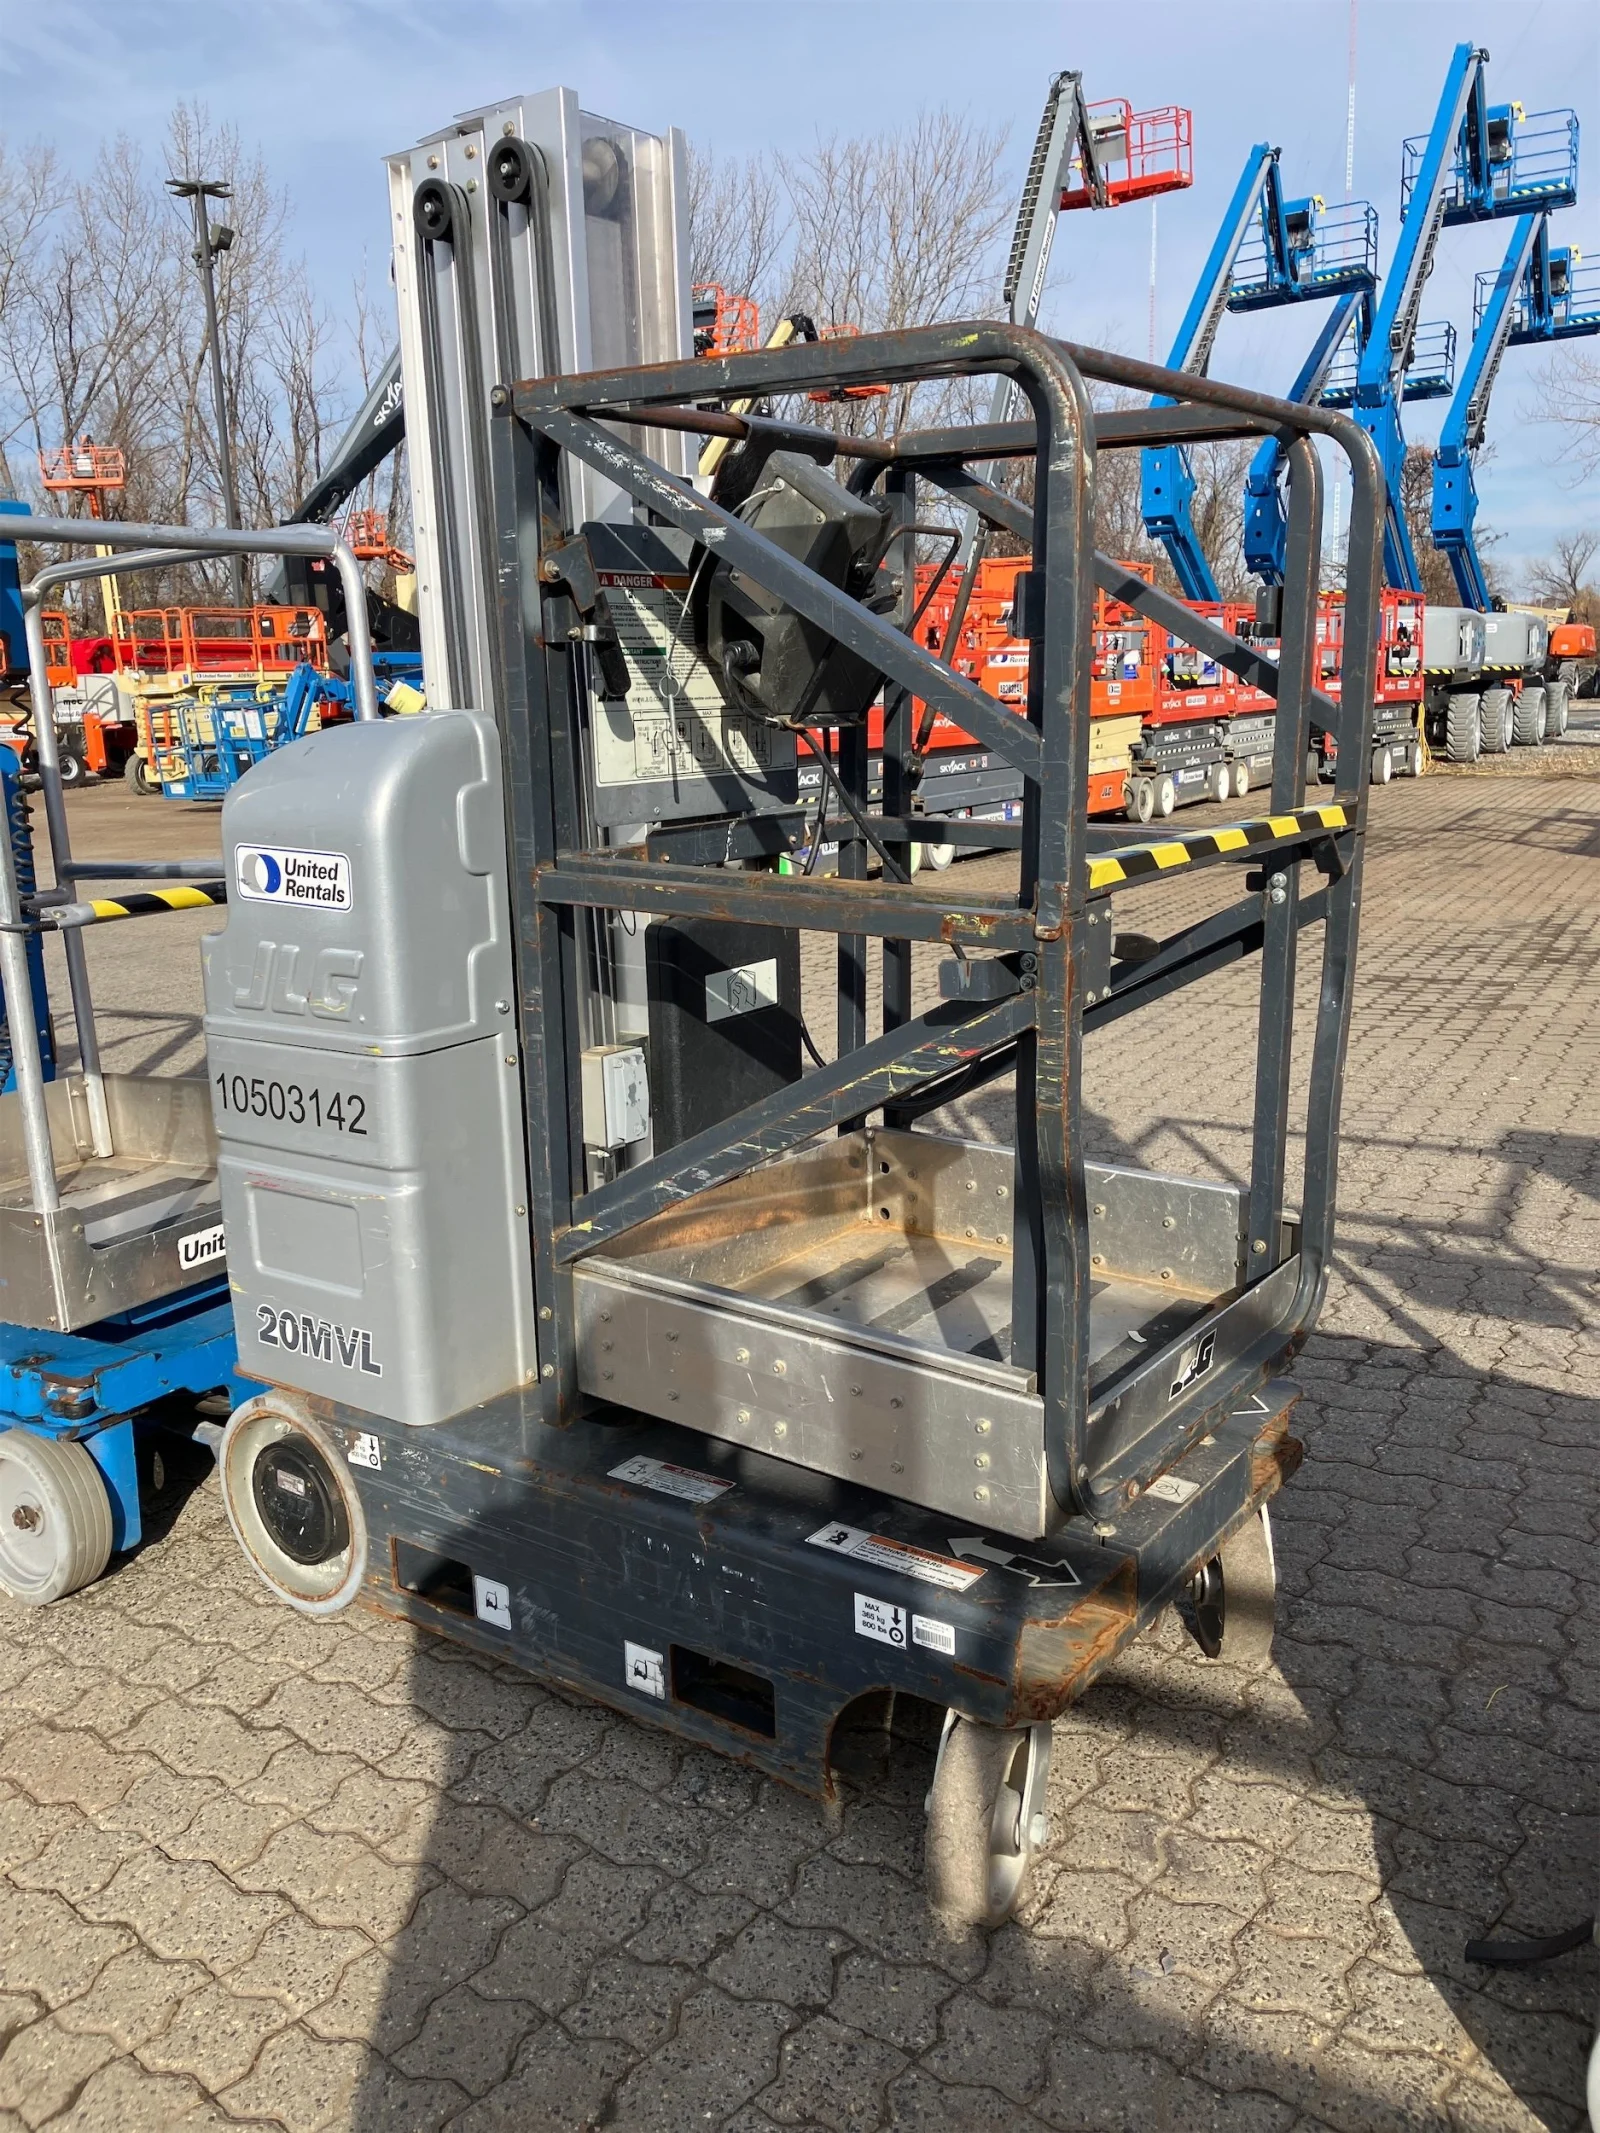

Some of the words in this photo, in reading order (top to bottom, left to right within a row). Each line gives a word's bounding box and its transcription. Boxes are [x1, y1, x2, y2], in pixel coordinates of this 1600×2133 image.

[374, 381, 403, 426] SKYJA
[613, 575, 653, 587] DANGER
[939, 760, 967, 774] SKYJACK
[284, 857, 339, 881] United
[285, 878, 346, 903] Rentals
[233, 941, 365, 1023] JLG
[216, 1072, 368, 1136] 10503142
[183, 1233, 226, 1263] Unit
[256, 1303, 383, 1378] 20MVL
[865, 1541, 907, 1557] CRUSHING
[908, 1555, 943, 1568] HAZARD
[864, 1602, 880, 1613] MAX
[876, 1614, 886, 1625] kg
[862, 1620, 876, 1630] 800
[877, 1625, 887, 1634] lbs
